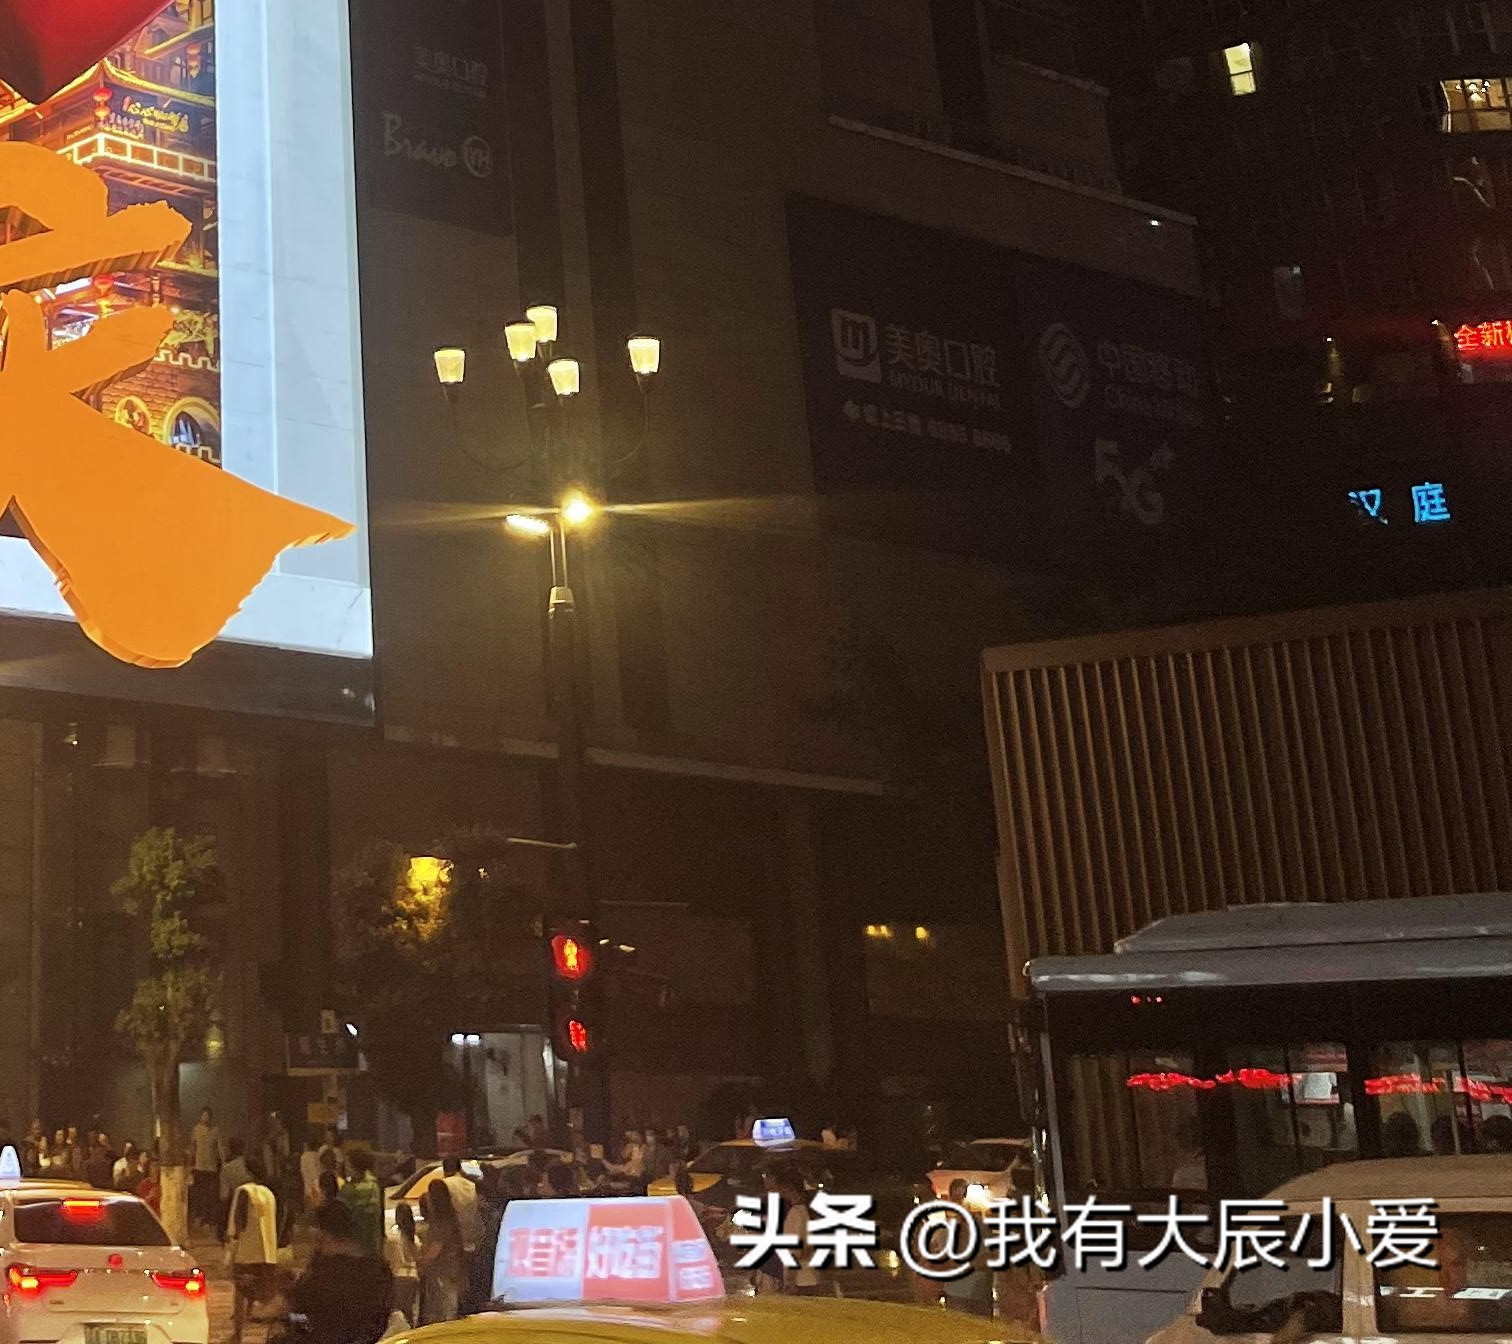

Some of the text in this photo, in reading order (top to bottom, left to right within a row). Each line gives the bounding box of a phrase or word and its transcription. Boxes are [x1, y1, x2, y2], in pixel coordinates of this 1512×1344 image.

[383, 111, 457, 169] Bravo
[885, 322, 1001, 388] 美奥口腔
[1348, 481, 1451, 526] 汉庭
